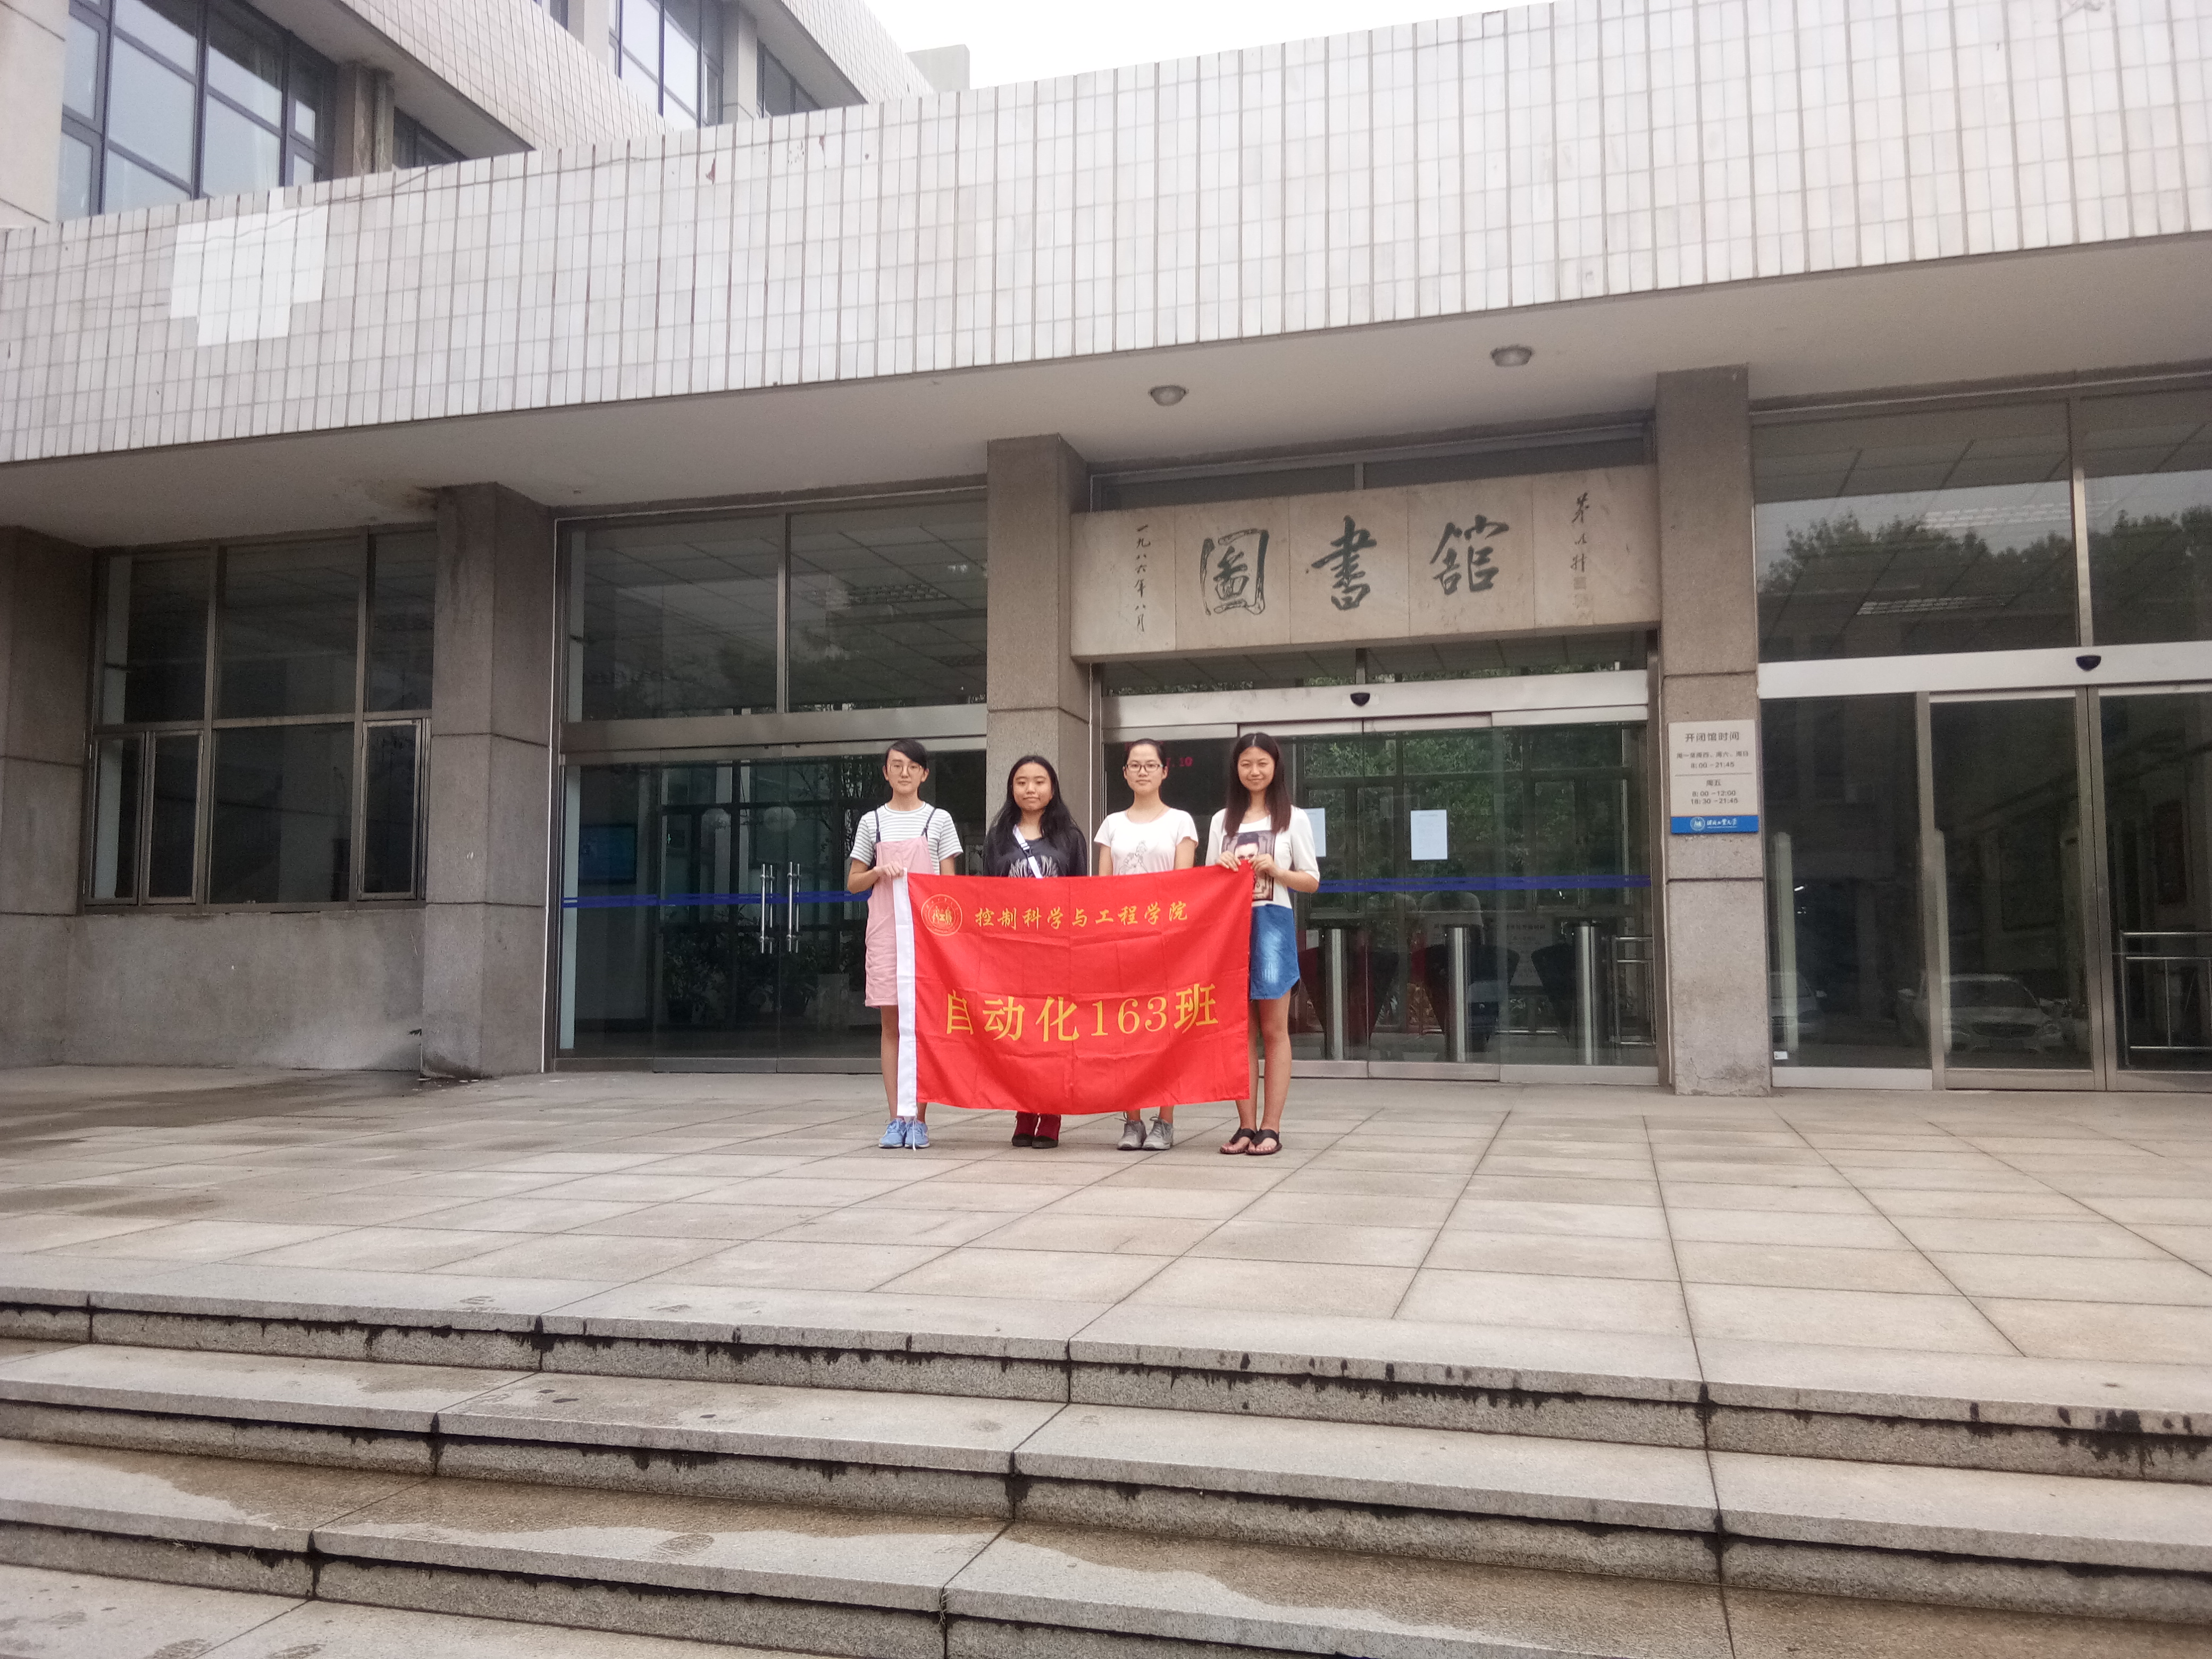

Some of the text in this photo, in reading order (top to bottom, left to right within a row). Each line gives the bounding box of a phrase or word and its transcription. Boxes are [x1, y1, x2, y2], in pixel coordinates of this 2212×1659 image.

[1200, 514, 1509, 617] 圖書館
[1685, 731, 1740, 743] 开闭馆时间
[974, 900, 1188, 931] 控制科学与工程学院
[946, 982, 1219, 1043] 自动化163班
